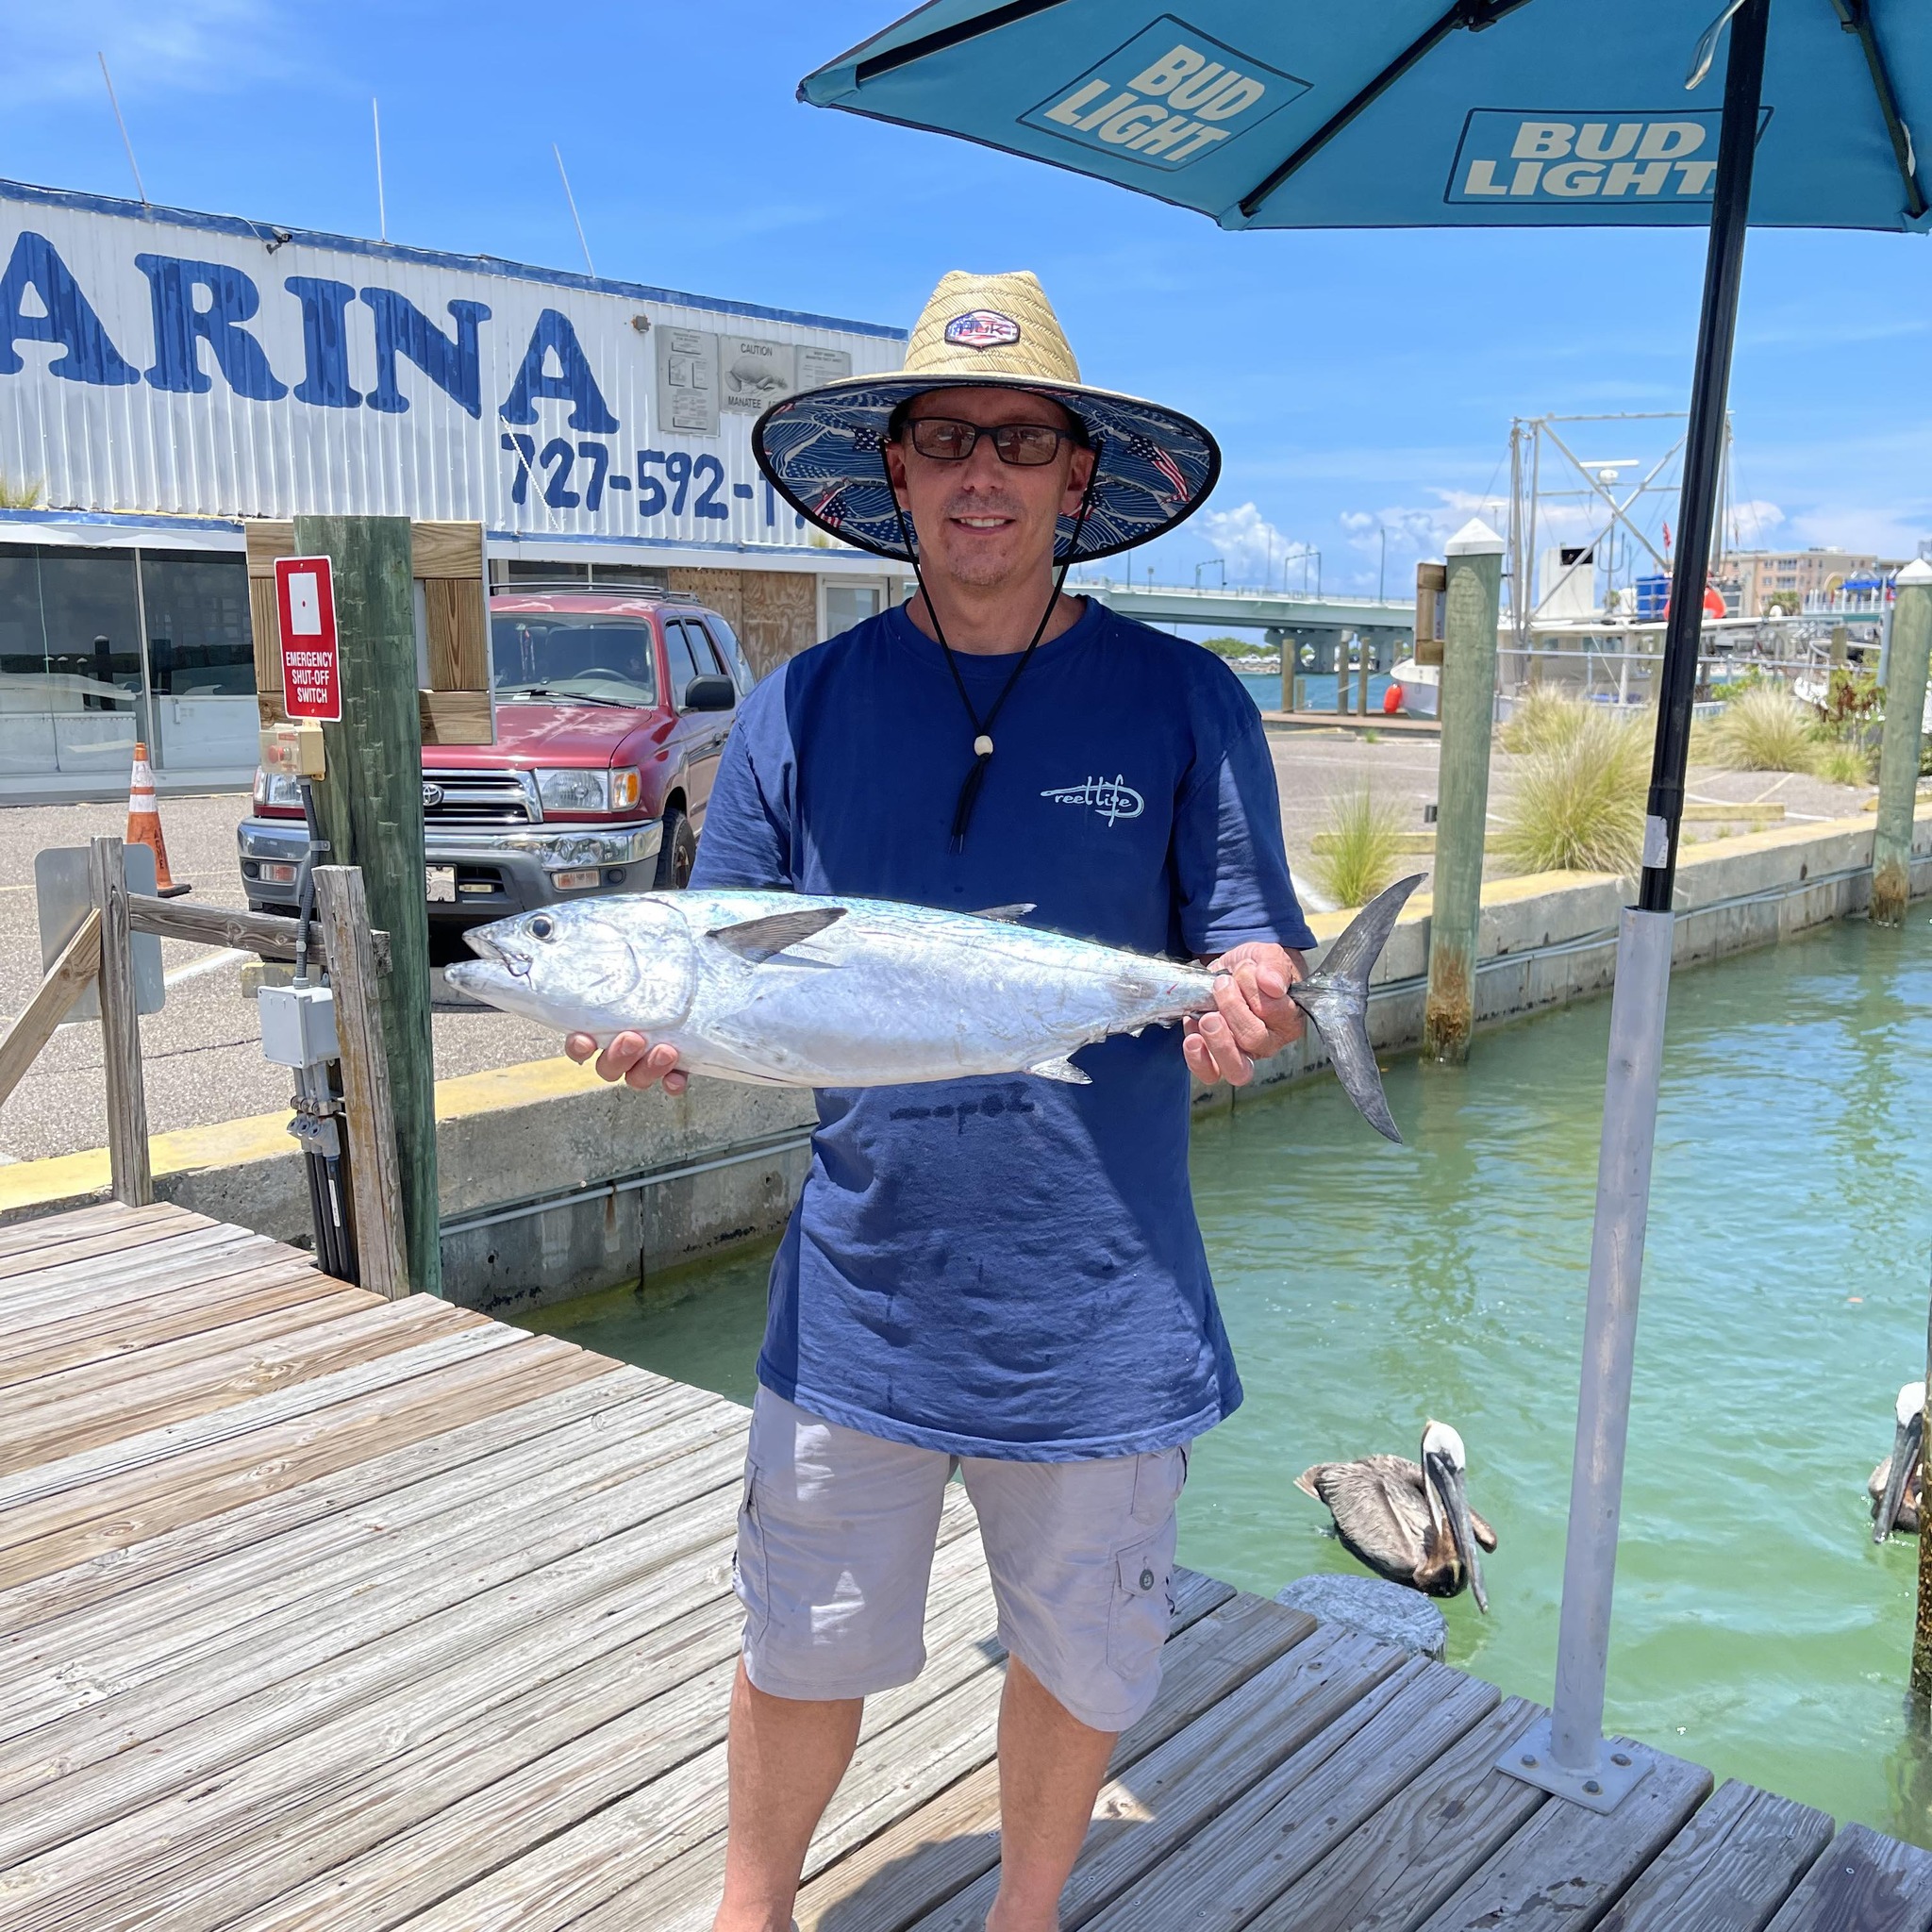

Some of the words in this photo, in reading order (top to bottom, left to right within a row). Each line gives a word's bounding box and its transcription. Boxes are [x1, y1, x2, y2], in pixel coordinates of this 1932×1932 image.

[1126, 44, 1265, 121] BUD
[1043, 78, 1231, 162] LIGHT
[1510, 122, 1706, 160] BUD
[1463, 159, 1718, 196] LIGHT
[0, 231, 619, 434] ARINA
[741, 342, 773, 357] CAUTION
[728, 395, 761, 408] MANATEE
[501, 433, 806, 529] 727-592-1
[286, 652, 332, 667] EMERGENCY
[291, 670, 329, 686] SHUT-OFF
[297, 688, 327, 704] SWITCH
